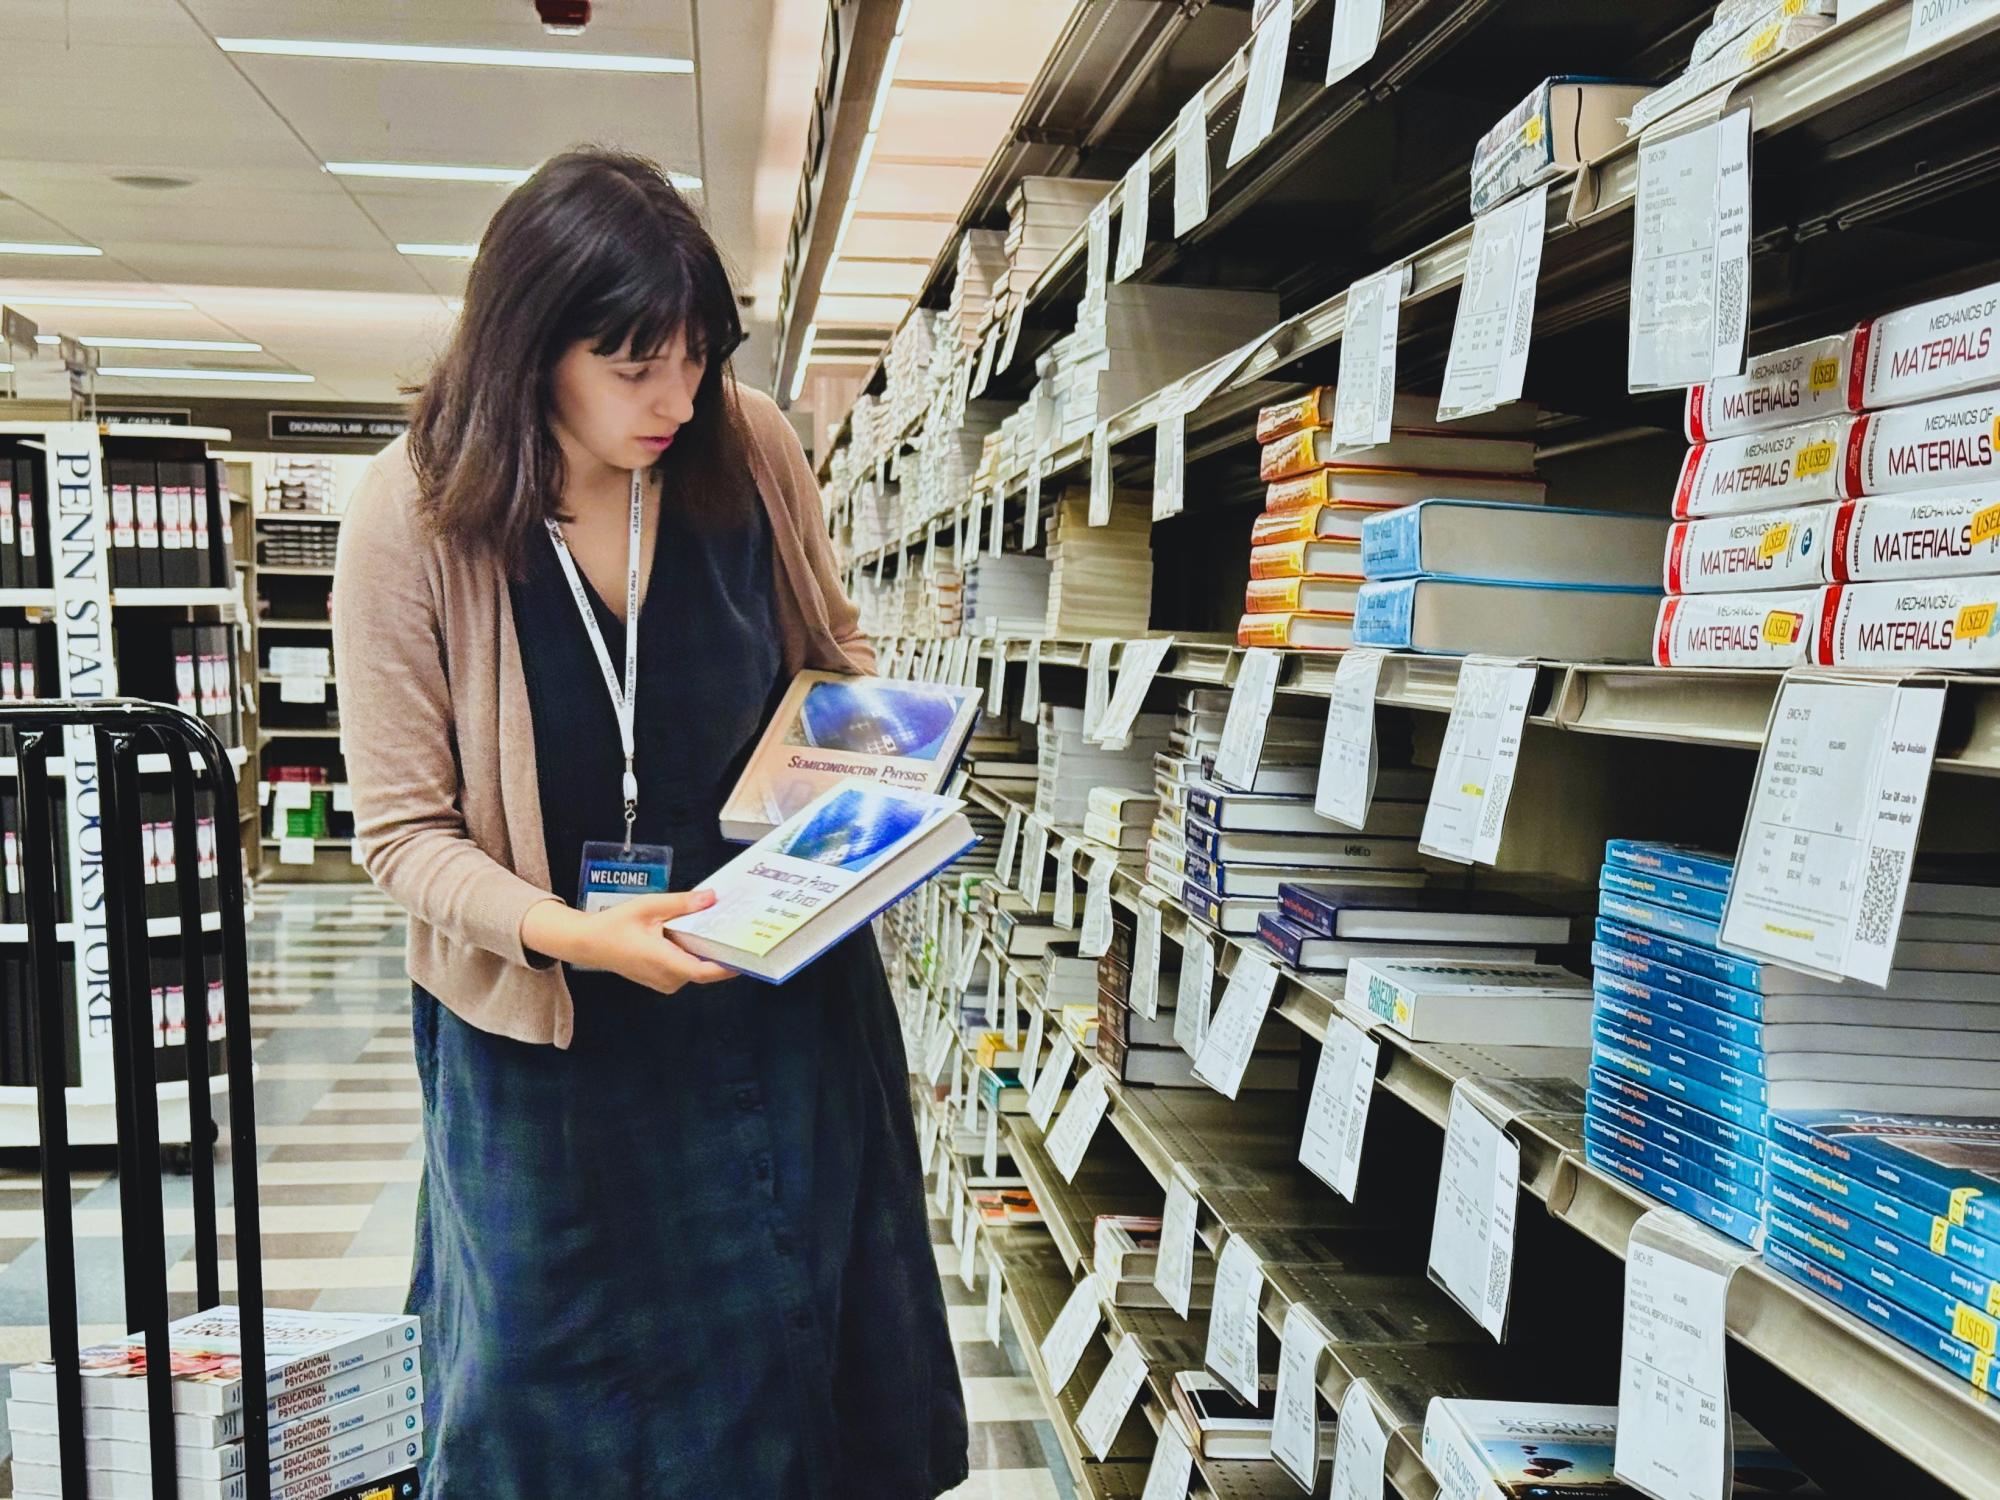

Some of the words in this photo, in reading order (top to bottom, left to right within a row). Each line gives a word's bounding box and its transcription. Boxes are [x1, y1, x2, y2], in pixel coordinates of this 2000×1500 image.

[1929, 303, 1982, 332] MECHANICS
[1983, 298, 1998, 317] OF
[1869, 322, 1884, 394] HIBBELER
[1890, 327, 1992, 381] MATERIALS
[1750, 360, 1791, 381] MECHANICS
[1792, 356, 1804, 371] OF
[1813, 363, 1836, 385] USED
[1723, 379, 1800, 422] MATERIALS
[1924, 409, 1979, 433] MECHANICS
[1979, 406, 1995, 424] OF
[1744, 440, 1785, 459] MECHANICS
[1784, 436, 1796, 450] OF
[1808, 447, 1831, 469] USED
[1866, 417, 1882, 488] HIBBELER
[1889, 434, 1992, 477] MATERIALS
[1711, 459, 1790, 497] MATERIALS
[56, 449, 97, 584] PENN
[1764, 528, 1787, 553] USED
[1853, 504, 1868, 574] HIBBELER
[1873, 524, 1973, 564] MATERIALS
[1895, 595, 1947, 612] MECHANICS
[1769, 617, 1791, 638] USED
[1840, 592, 1854, 660] HIBBELER
[1960, 608, 1990, 632] USED
[1688, 624, 1760, 651] MATERIALS
[1858, 619, 1954, 652] MATERIALS
[787, 755, 878, 777] SEMICONDUCTOR
[880, 765, 929, 784] PHYSICS
[590, 870, 649, 886] WELCOME!
[1957, 1310, 1991, 1350] USED
[284, 1353, 332, 1377] EDUCATIONAL
[284, 1365, 332, 1389] PSYCHOLOGY
[338, 1354, 364, 1370] TEACHING
[277, 1383, 327, 1407] EDUCATIONAL
[278, 1394, 327, 1418] PSYCHOLOGY
[334, 1384, 361, 1400] TEACHING
[283, 1414, 331, 1439] EDUCATIONAL
[283, 1425, 332, 1450] PSYCHOLOGY
[338, 1414, 364, 1431] TEACHING
[1499, 1417, 1618, 1431] ECONO
[283, 1444, 331, 1469] EDUCATIONAL
[283, 1455, 332, 1480] PSYCHOLOGY
[338, 1443, 364, 1459] TEACHING
[284, 1472, 332, 1497] EDUCATIONAL
[340, 1472, 365, 1488] TEACHING
